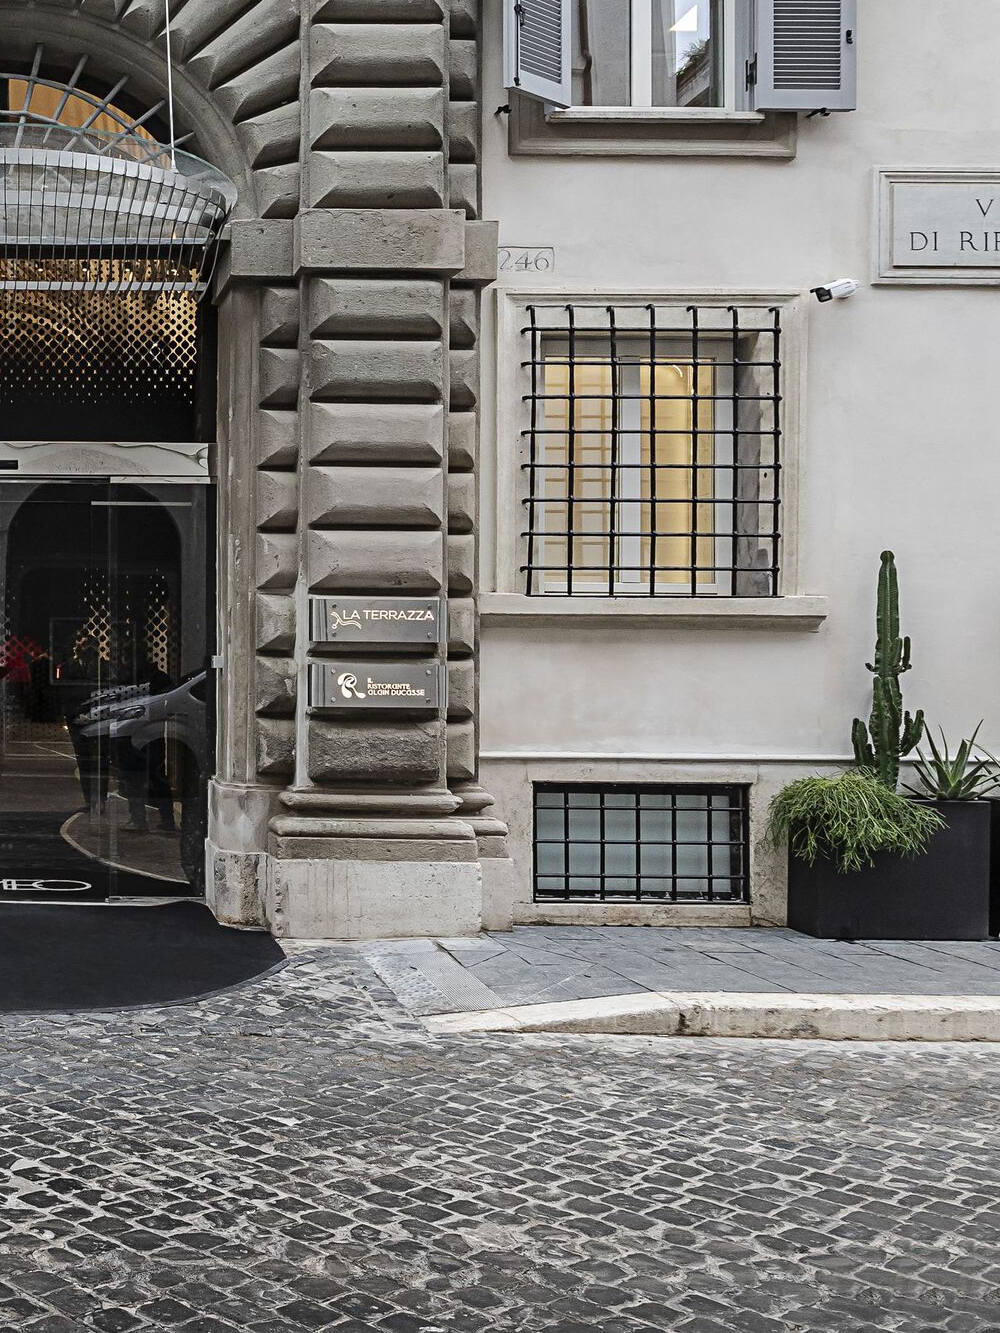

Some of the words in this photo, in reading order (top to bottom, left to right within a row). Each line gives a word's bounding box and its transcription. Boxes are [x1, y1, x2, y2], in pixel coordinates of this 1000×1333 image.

[909, 231, 938, 251] DI
[498, 249, 550, 271] 246
[342, 610, 361, 620] LA
[363, 610, 434, 621] TERRAZZA
